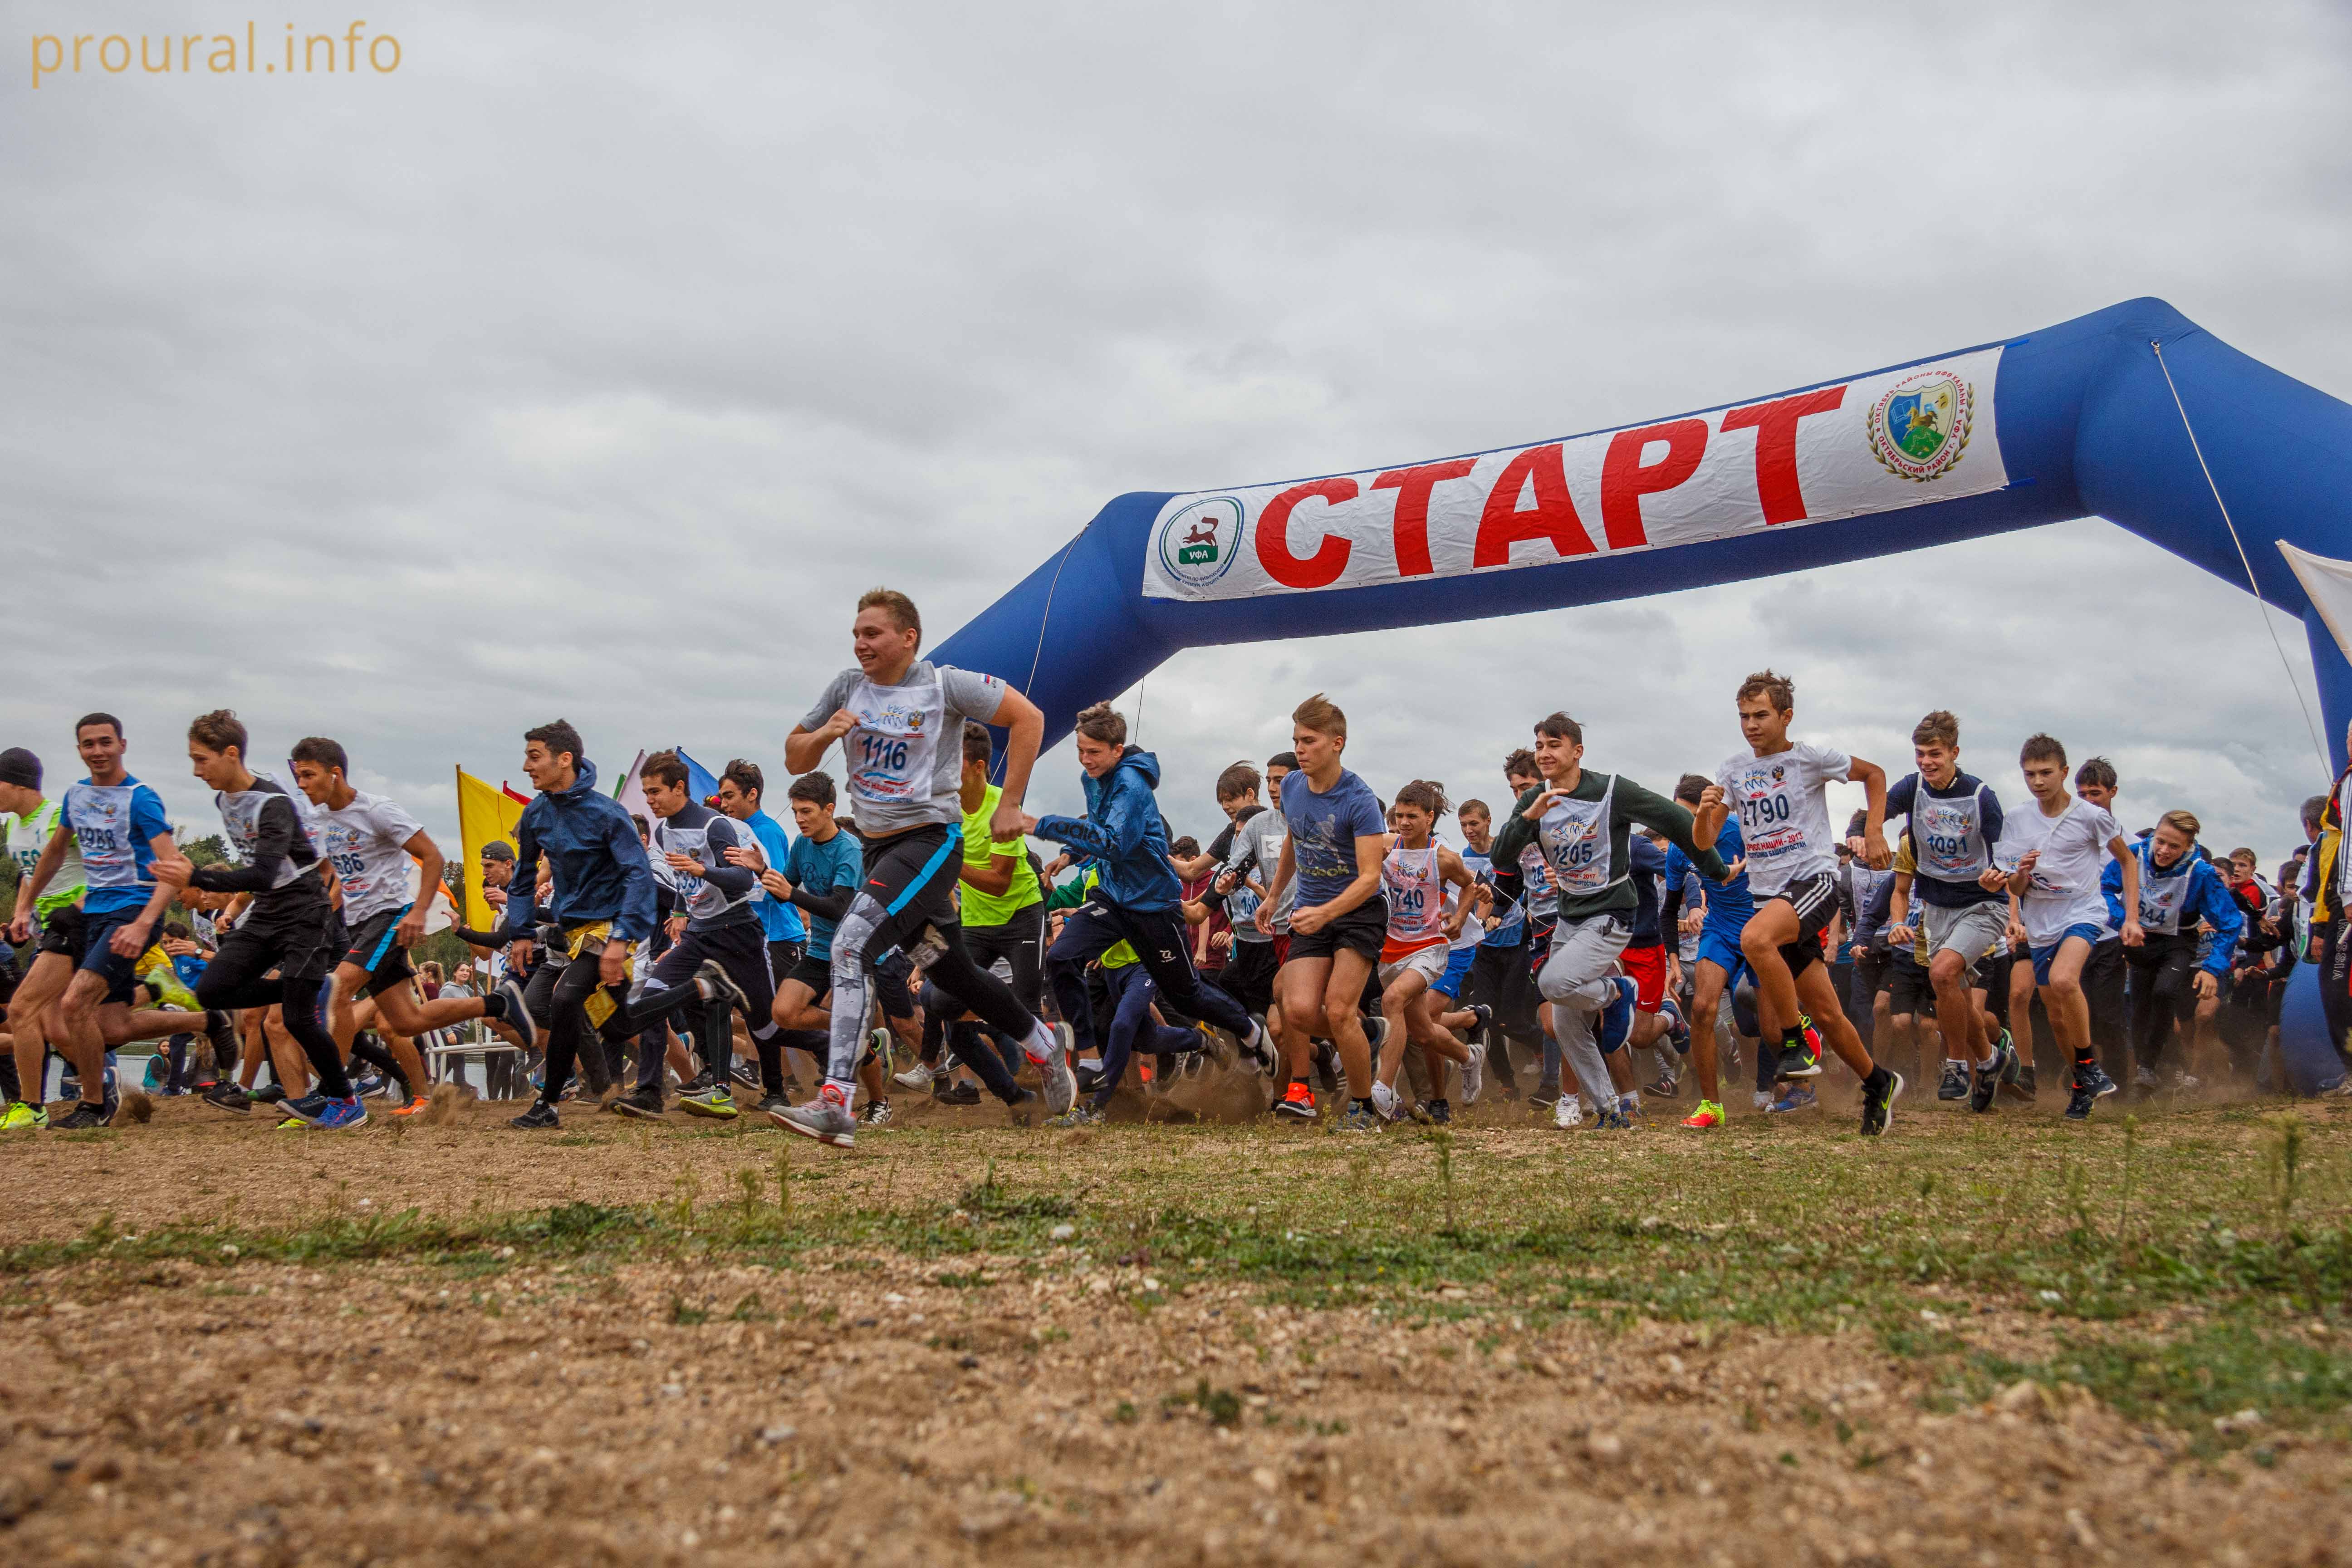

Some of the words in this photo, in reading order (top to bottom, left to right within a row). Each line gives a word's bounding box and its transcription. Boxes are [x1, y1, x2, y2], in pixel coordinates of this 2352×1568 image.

[1874, 389, 1895, 423] ОКТЯБРЬ
[1896, 371, 1932, 388] РАЙОНЫ
[1878, 436, 1924, 473] ОКТЯБРЬСКИЙ
[1926, 450, 1950, 472] РАЙОН
[1951, 419, 1963, 439] УФА
[1255, 385, 1847, 588] СТАРТ
[1189, 550, 1208, 559] УФА
[1172, 566, 1191, 580] КОМИТЕТ
[1199, 564, 1225, 581] ФИЗИЧЕСКОЙ
[1205, 577, 1220, 587] СПОРТУ
[862, 735, 908, 770] 1116
[1740, 794, 1789, 827] 2790
[1553, 843, 1592, 866] 1205
[1761, 838, 1784, 850] НАЦИИ
[1768, 841, 1807, 857] БАШКОРТОСТАН
[1927, 835, 1968, 855] 1091
